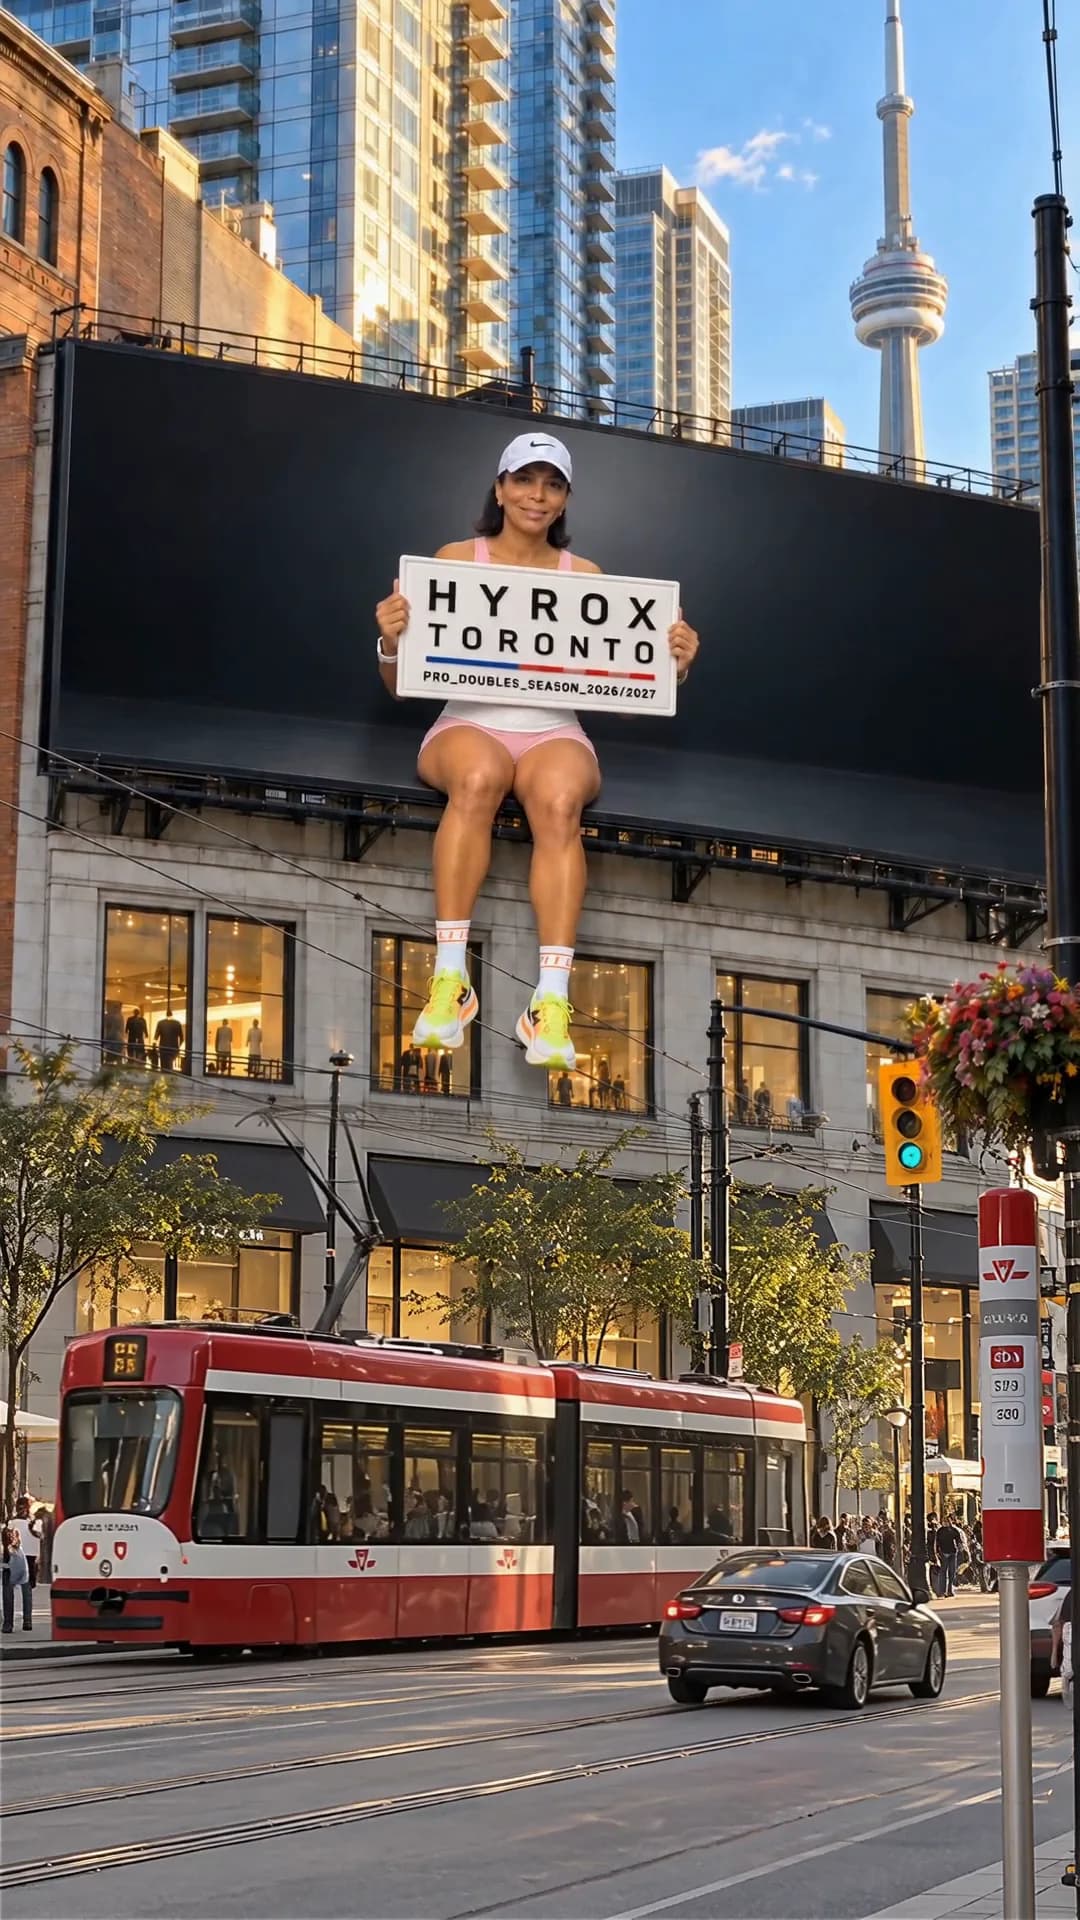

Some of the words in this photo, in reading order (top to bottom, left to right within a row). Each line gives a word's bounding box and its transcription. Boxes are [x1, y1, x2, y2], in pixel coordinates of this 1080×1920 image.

[429, 579, 656, 630] HYROX
[429, 623, 654, 663] TORONTO
[423, 671, 656, 699] PRO_DOUBLES_SEASON_2026/2027
